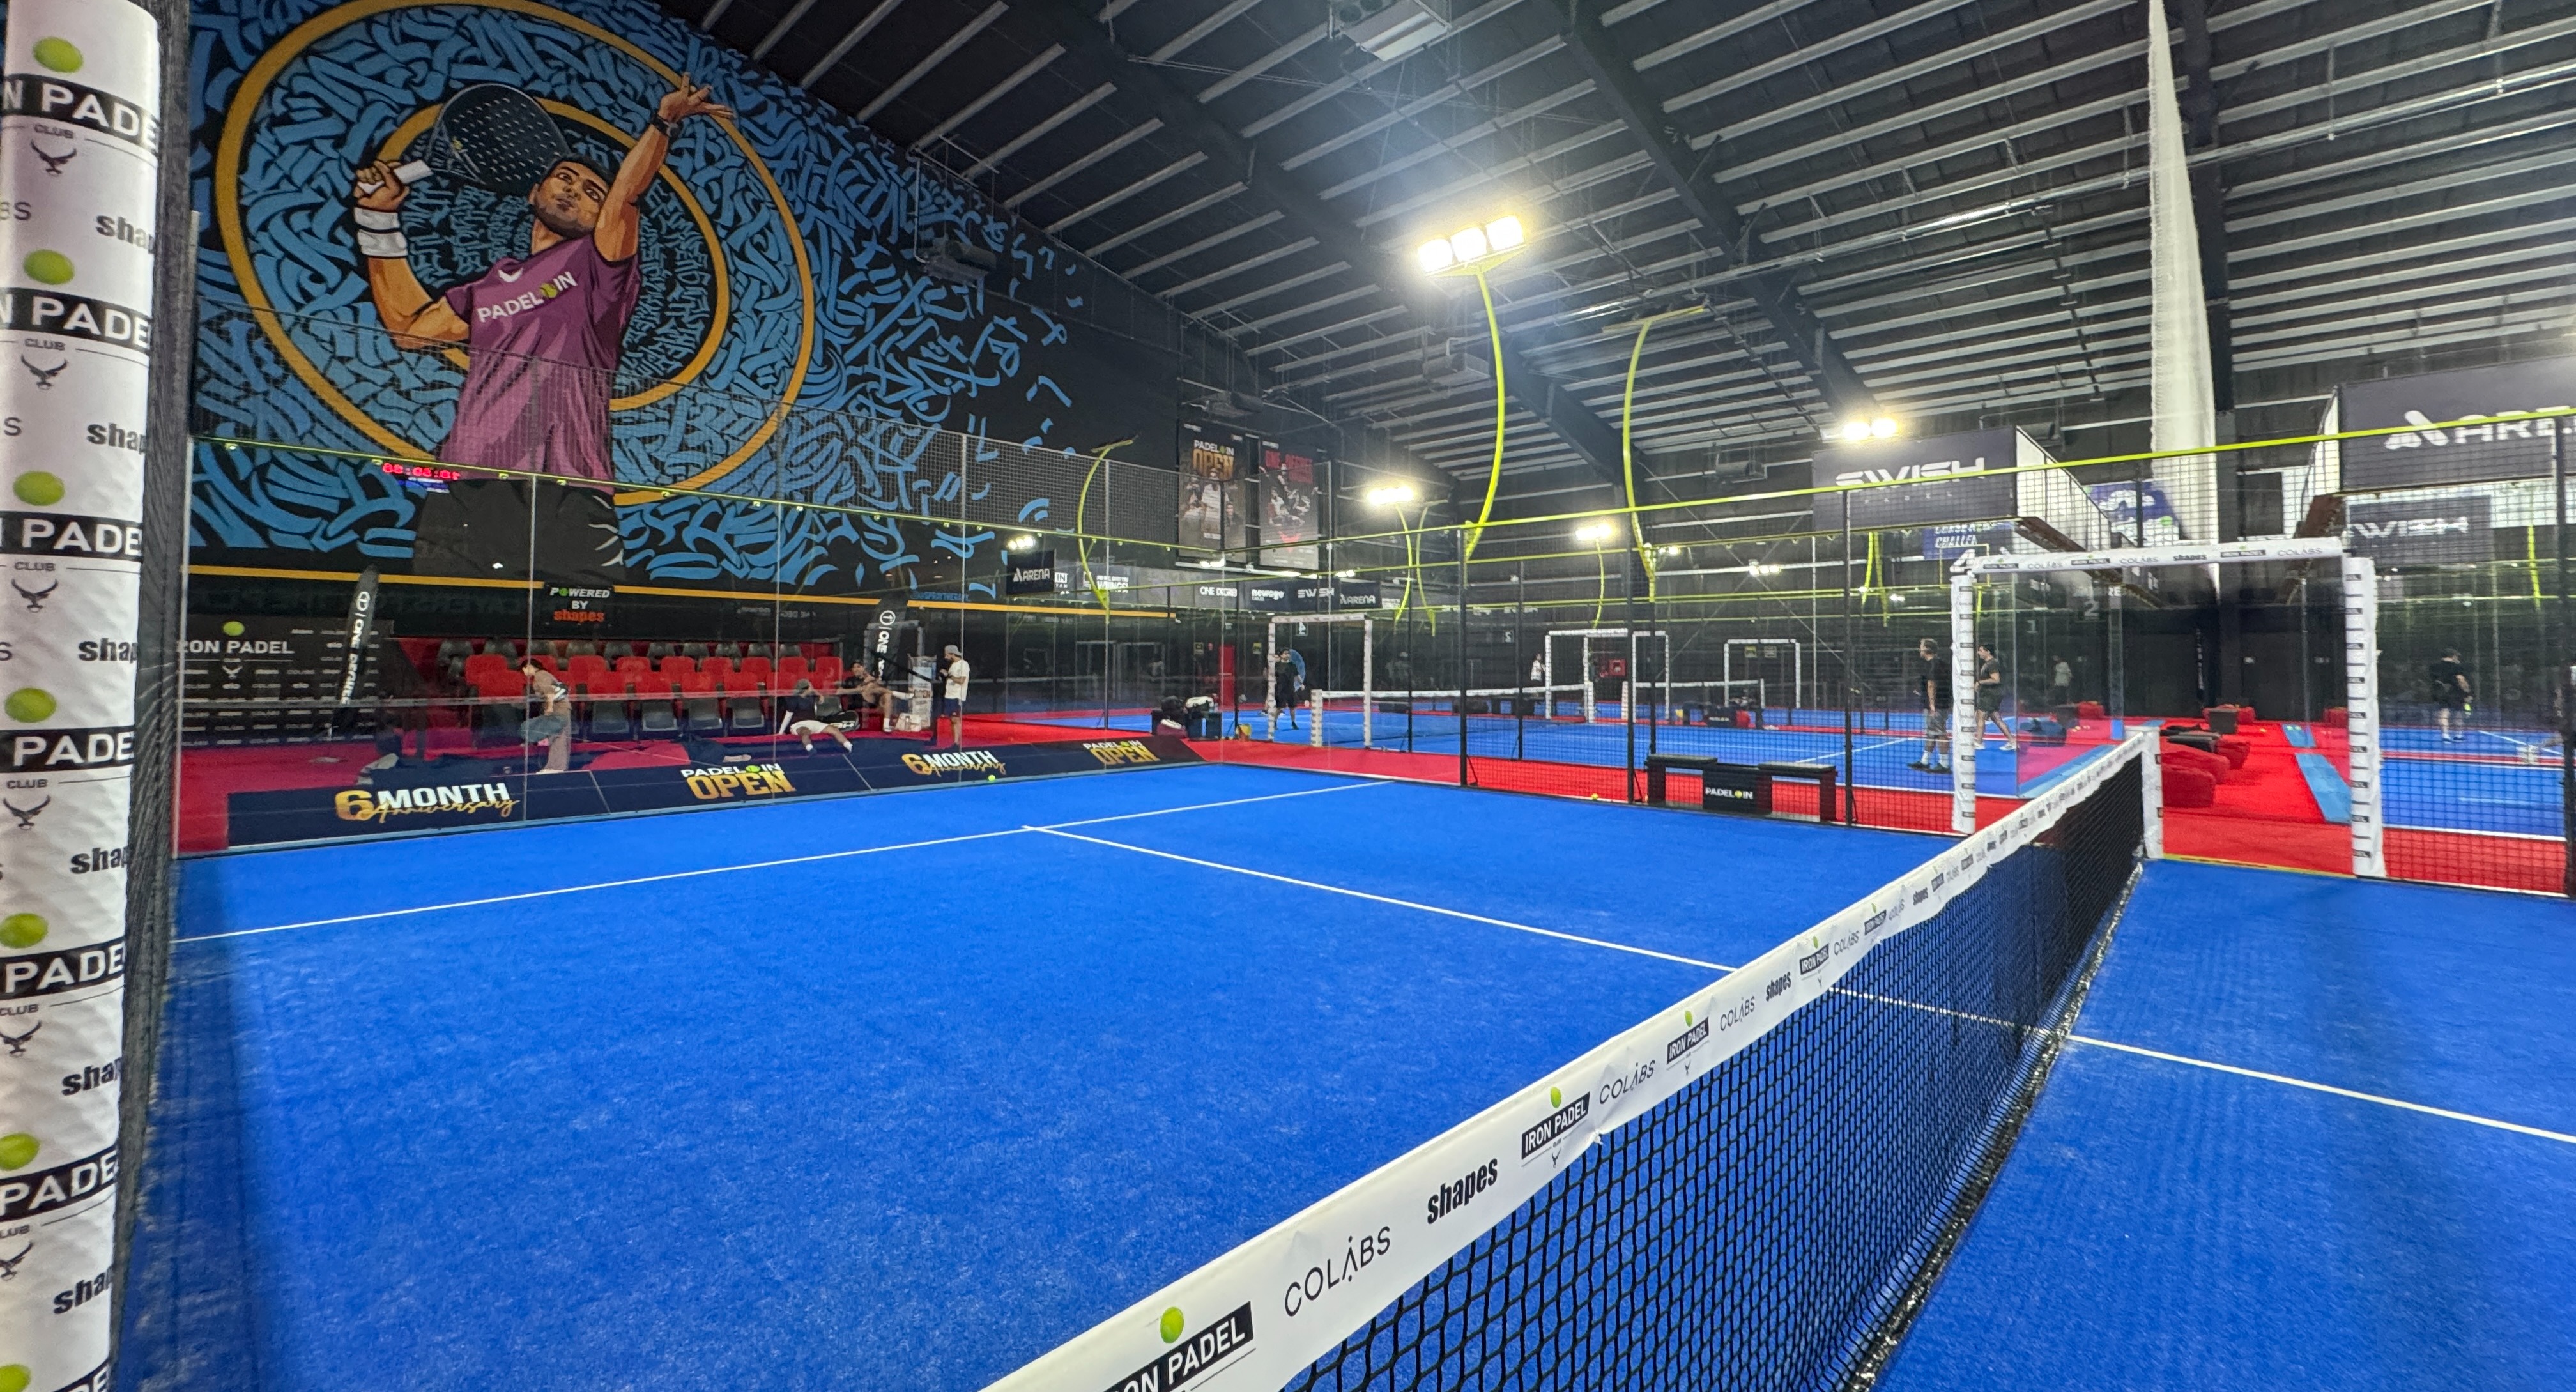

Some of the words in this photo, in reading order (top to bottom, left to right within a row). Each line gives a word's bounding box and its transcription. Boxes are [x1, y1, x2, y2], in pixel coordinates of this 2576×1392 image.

[34, 124, 74, 139] CLUB
[477, 291, 544, 323] PADEL
[553, 271, 578, 291] IN
[24, 338, 66, 351] CLUB
[1193, 440, 1220, 454] PADEL
[1225, 447, 1234, 455] IN
[1192, 448, 1234, 480] OPEN
[1836, 457, 1984, 494] SWISH
[14, 562, 56, 572] CLUB
[1022, 568, 1050, 581] ARENA
[1298, 587, 1335, 599] SWSH
[1347, 595, 1376, 604] ARENA
[571, 600, 589, 609] BY
[227, 640, 295, 654] PADEL
[877, 631, 890, 654] ONE
[1082, 741, 1119, 749] PADEL
[1090, 745, 1160, 765] OPEN
[680, 766, 746, 778] PADEL
[760, 763, 781, 772] IN
[902, 753, 932, 776] 6
[923, 751, 999, 767] MONTH
[6, 779, 48, 789] CLUB
[686, 770, 797, 799] OPEN
[1705, 787, 1735, 798] PADEL
[335, 790, 375, 821] 6
[378, 783, 510, 809] MONTH
[1765, 971, 1791, 1002] shapes
[1669, 1036, 1686, 1060] IRON
[1687, 1021, 1707, 1046] PADEL
[1524, 1120, 1552, 1154] IRON
[1554, 1098, 1586, 1134] PADEL
[1427, 1158, 1498, 1225] shapes
[0, 1225, 31, 1239] LUB
[1168, 1316, 1246, 1386] PADEL
